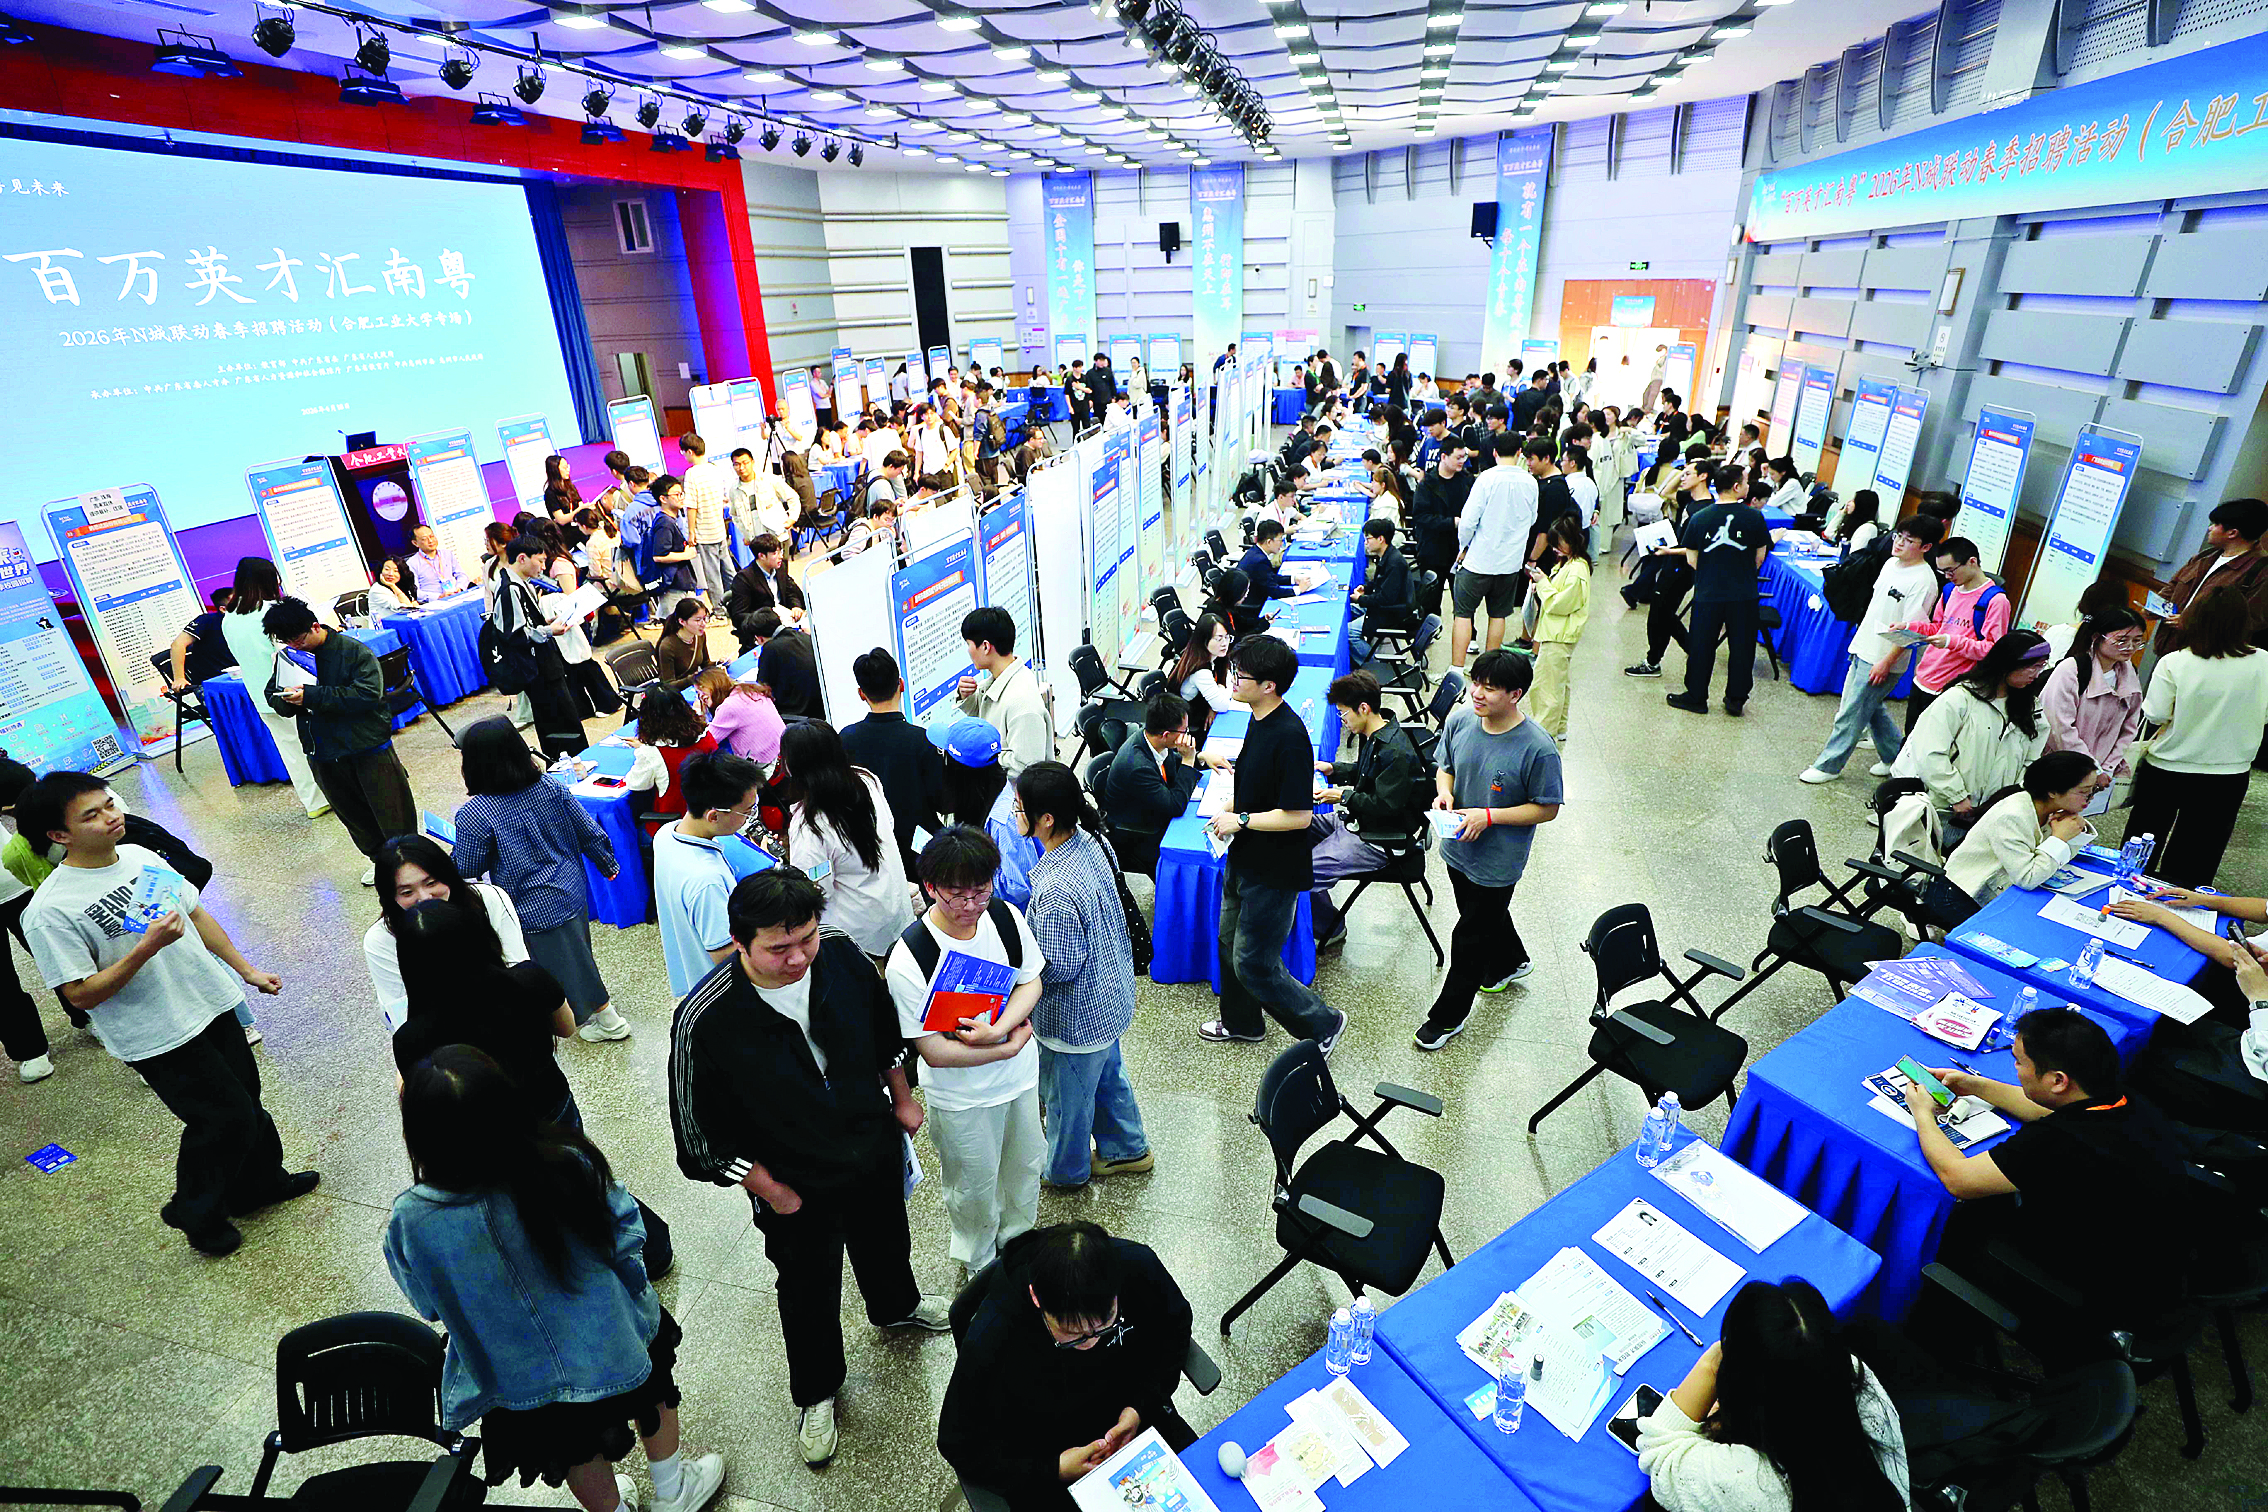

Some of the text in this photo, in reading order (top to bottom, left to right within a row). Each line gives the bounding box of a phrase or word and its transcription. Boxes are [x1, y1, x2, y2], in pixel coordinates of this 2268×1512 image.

[2, 245, 477, 307] 百万英才汇南粤
